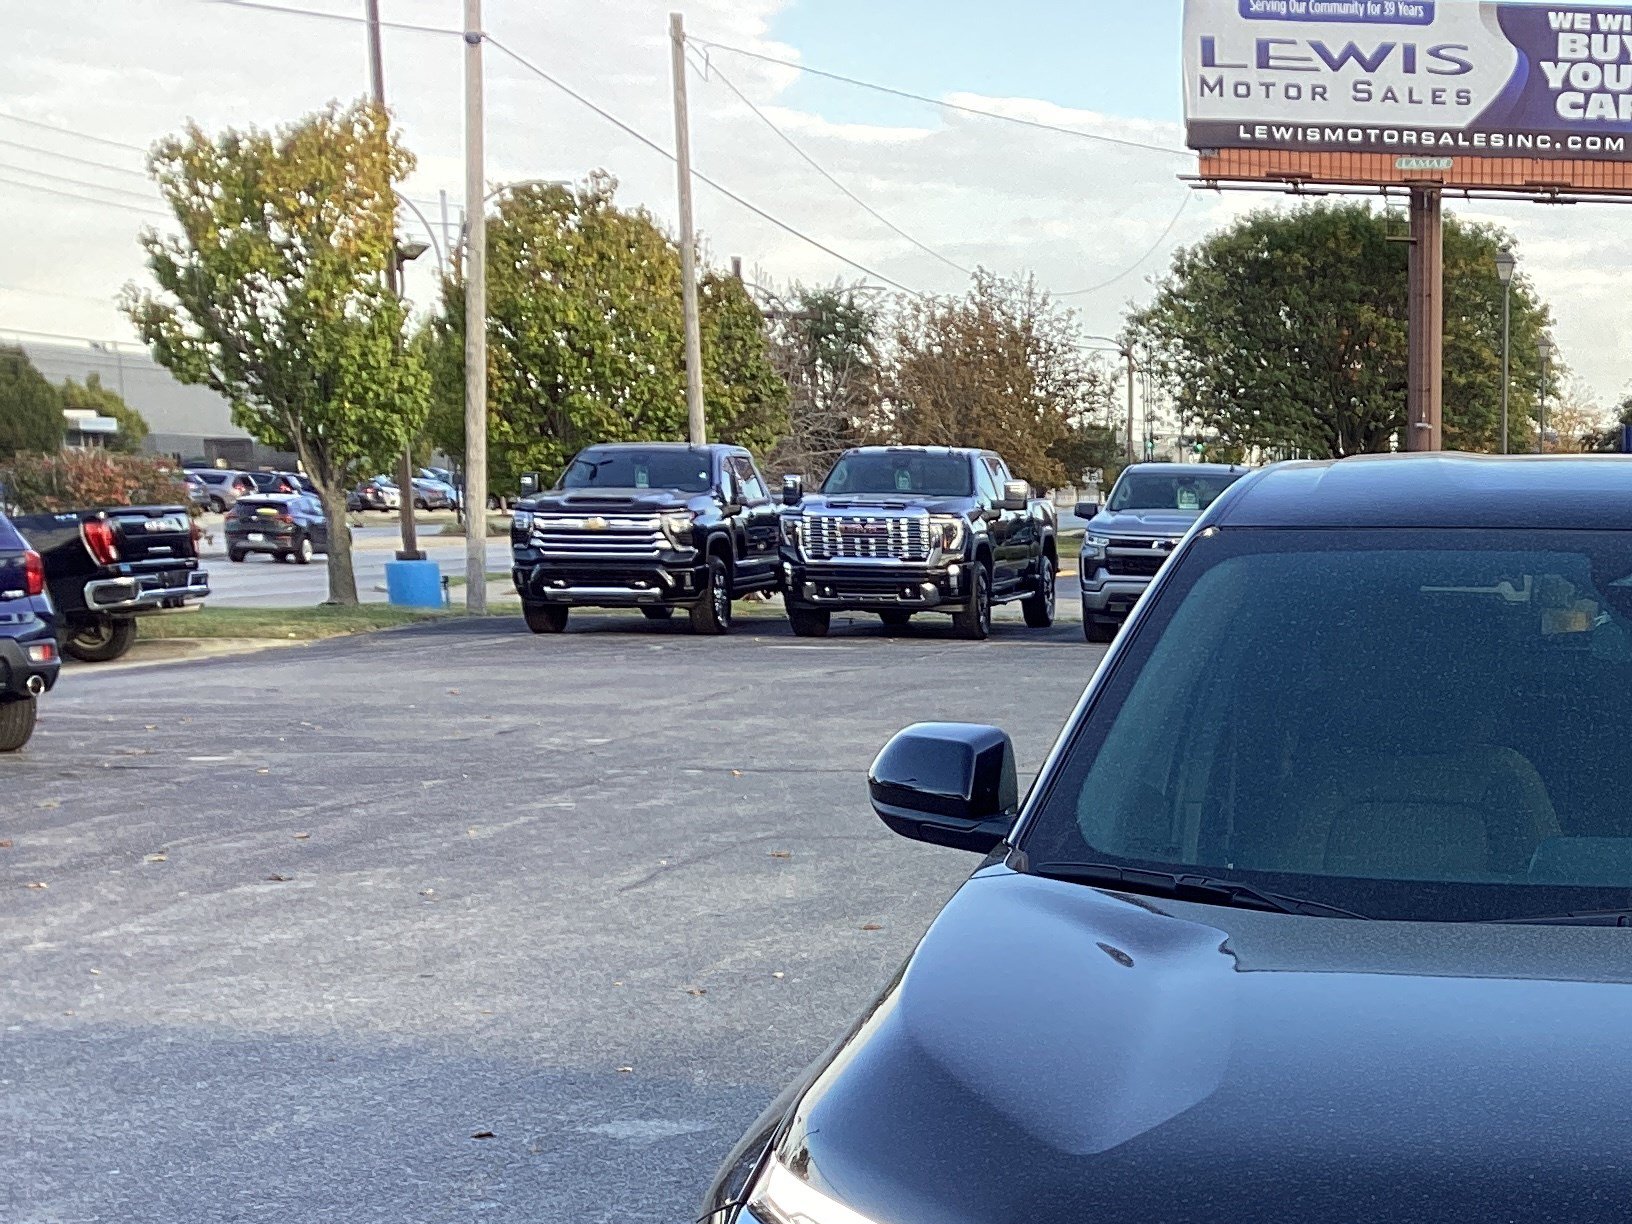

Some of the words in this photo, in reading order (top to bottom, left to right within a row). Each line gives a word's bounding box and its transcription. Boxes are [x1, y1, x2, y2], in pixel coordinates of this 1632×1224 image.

[1249, 0, 1287, 15] Serving
[1288, 0, 1306, 14] Our
[1308, 0, 1365, 17] Community
[1366, 1, 1381, 16] for
[1383, 1, 1395, 15] 39
[1398, 3, 1424, 17] Years
[1547, 11, 1591, 31] WE
[1199, 35, 1474, 76] LEWIS
[1199, 74, 1329, 101] MOTOR
[1351, 78, 1472, 105] SALES
[1238, 125, 1625, 151] LEWISMOTORSALESINC.COM
